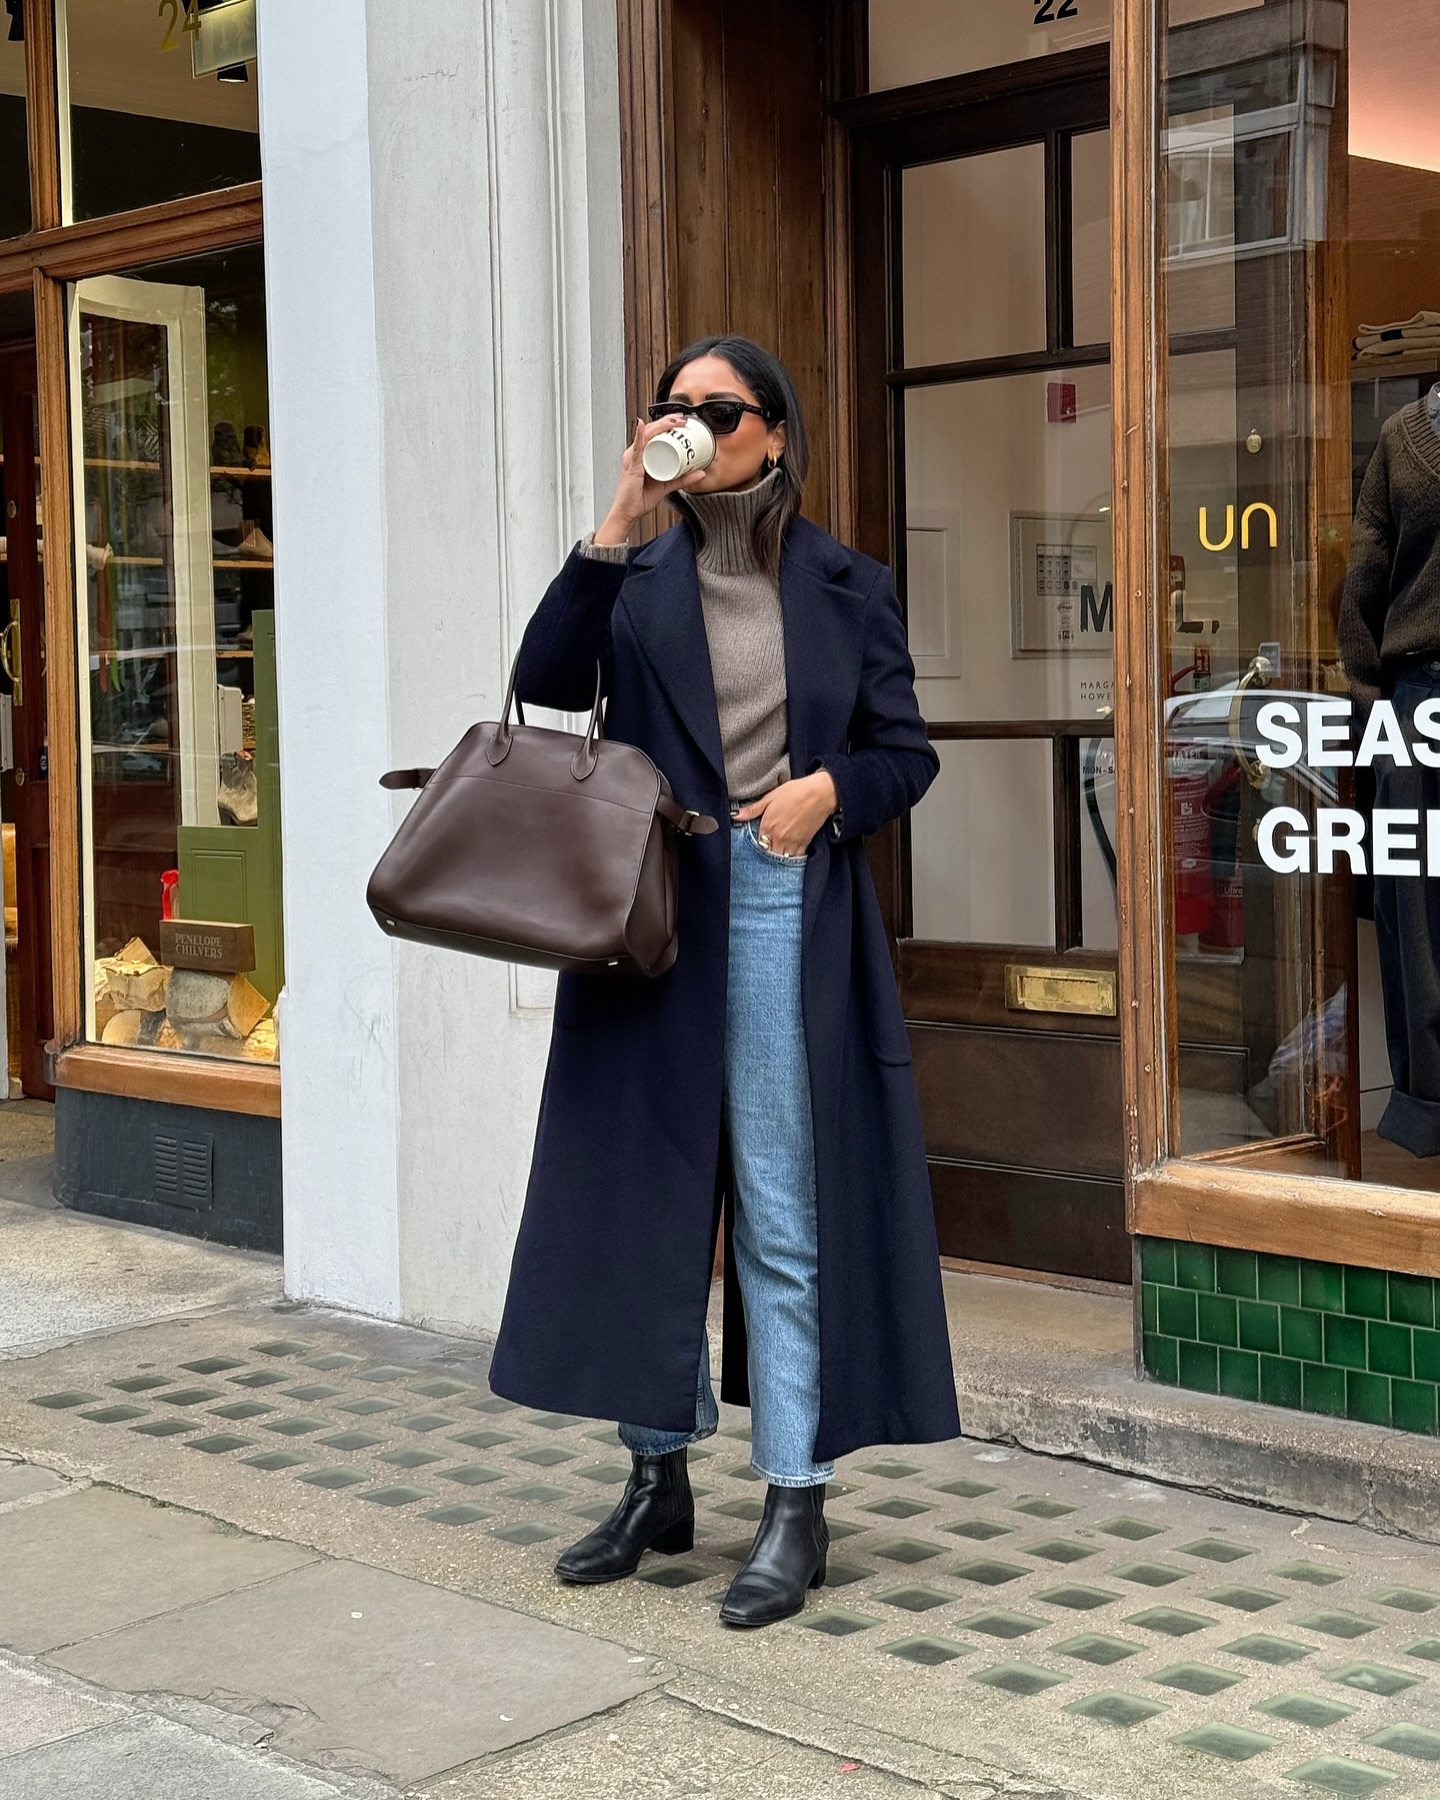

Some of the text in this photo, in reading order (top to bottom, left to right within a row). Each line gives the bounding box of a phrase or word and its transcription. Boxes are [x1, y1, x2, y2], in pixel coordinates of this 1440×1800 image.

[158, 0, 202, 51] 24
[1033, 0, 1078, 25] 22
[666, 428, 696, 466] use
[1255, 697, 1440, 769] SEAS
[1257, 806, 1440, 877] GRE
[175, 933, 223, 948] PENELOPE
[175, 944, 223, 959] CHILVERS
